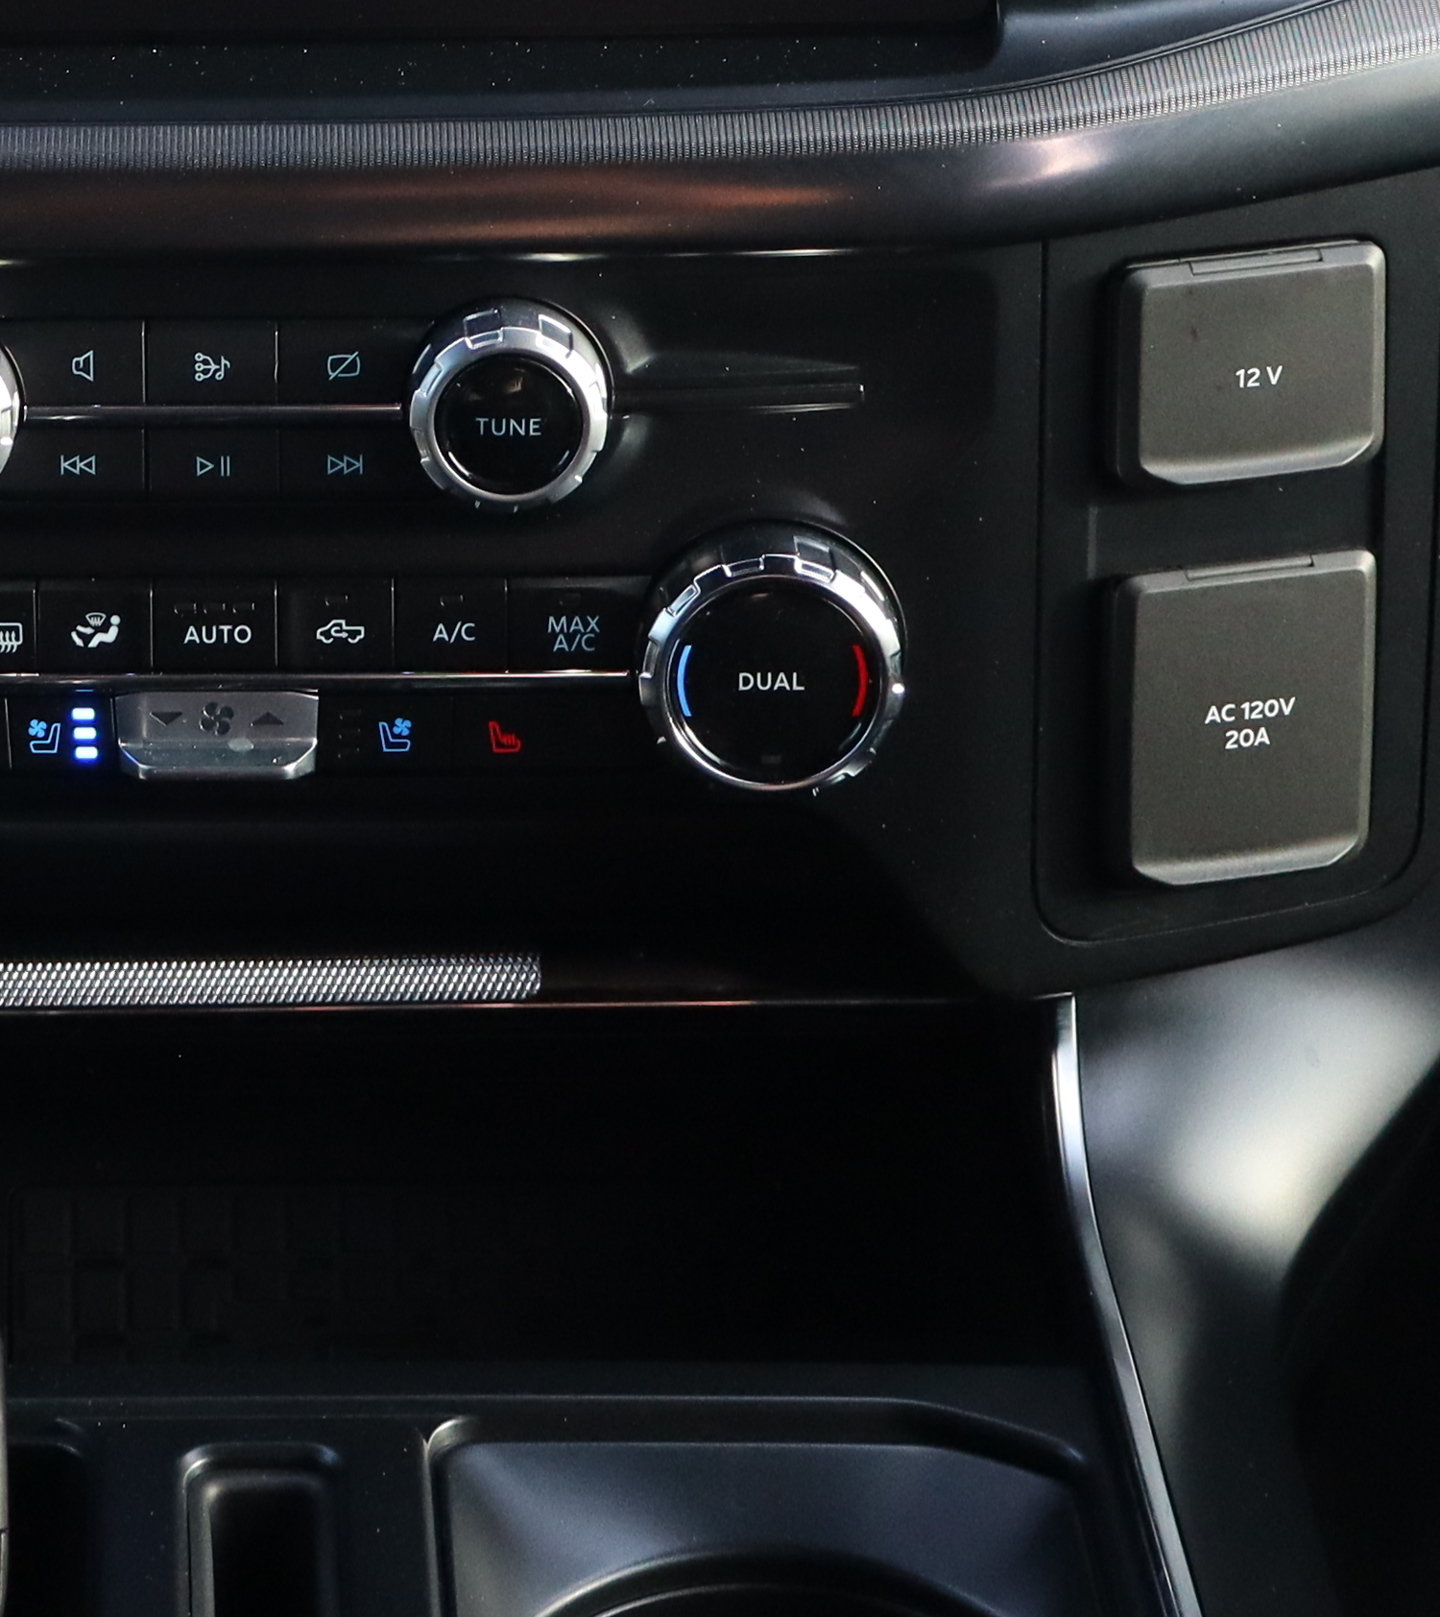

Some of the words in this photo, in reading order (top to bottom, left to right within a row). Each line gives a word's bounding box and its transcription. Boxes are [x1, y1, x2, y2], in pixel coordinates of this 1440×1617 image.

[1236, 368, 1260, 388] 12
[1266, 365, 1283, 385] V
[475, 417, 542, 437] TUNE
[183, 624, 253, 645] AUTO
[432, 622, 477, 644] A/C
[547, 615, 600, 633] MAX
[552, 633, 596, 654] A/C
[737, 672, 806, 691] DUAL
[1204, 705, 1236, 725] AC
[1240, 696, 1296, 720] 120V
[1224, 727, 1270, 750] 20A
